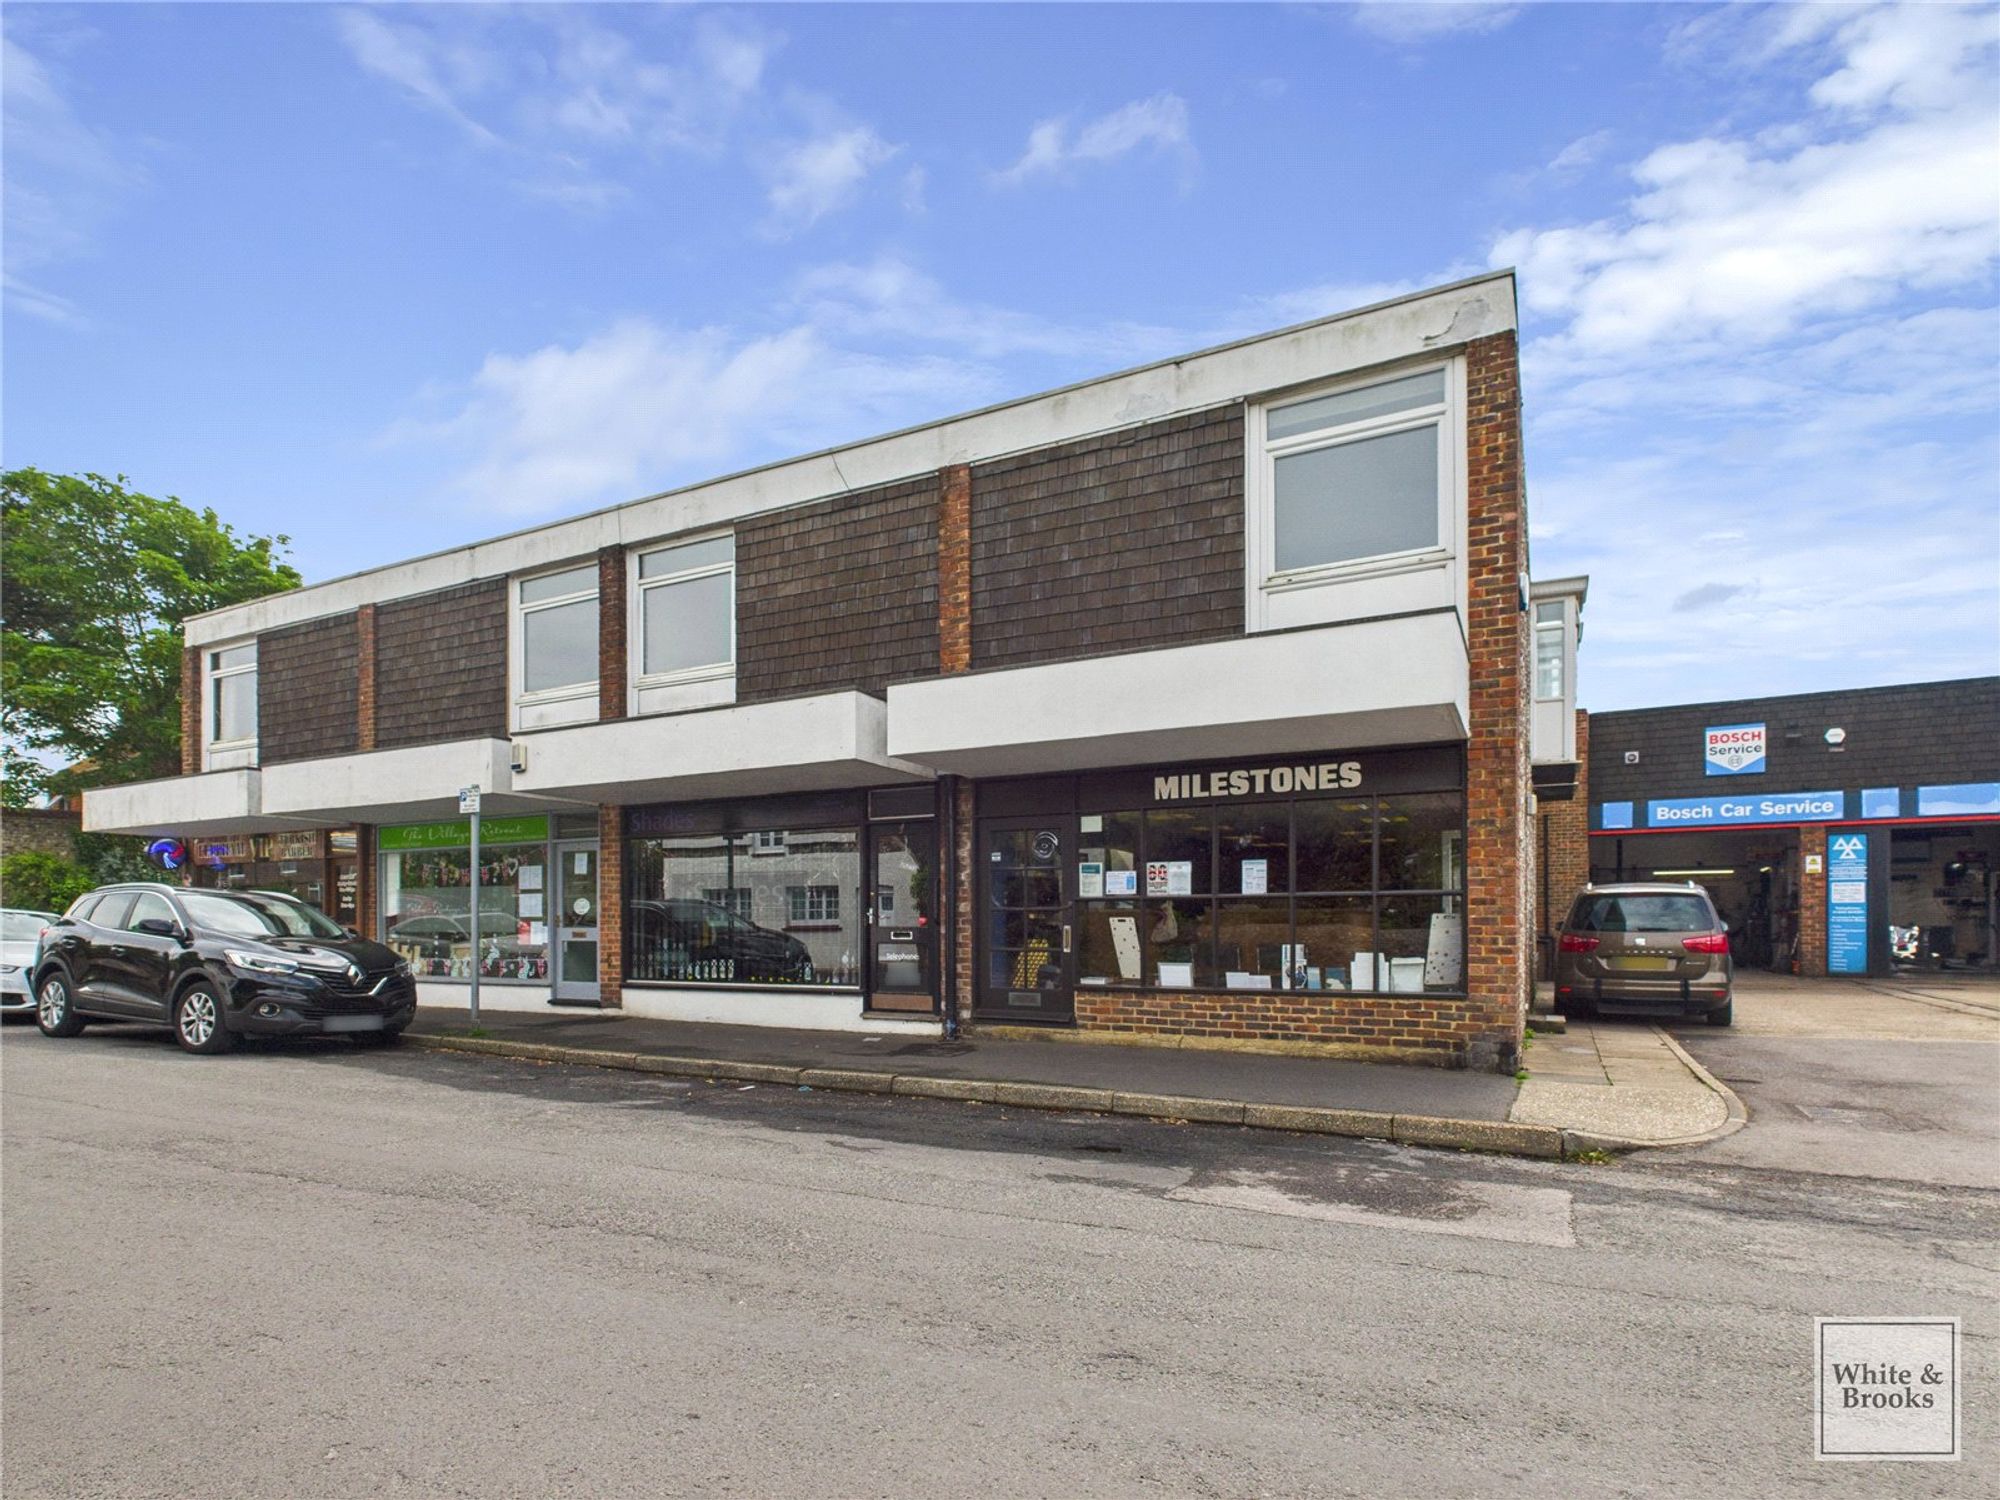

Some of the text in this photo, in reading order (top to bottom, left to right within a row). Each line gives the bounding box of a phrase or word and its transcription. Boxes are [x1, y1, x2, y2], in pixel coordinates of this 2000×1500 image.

[1709, 731, 1761, 744] BOSCH
[1709, 744, 1762, 756] Service
[1154, 761, 1362, 800] MILESTONES
[631, 808, 694, 831] Shades
[1656, 800, 1834, 820] Bosch Car Service
[402, 827, 422, 842] The
[428, 825, 471, 844] Village
[480, 822, 521, 838] Retreat
[249, 838, 273, 861] VIP
